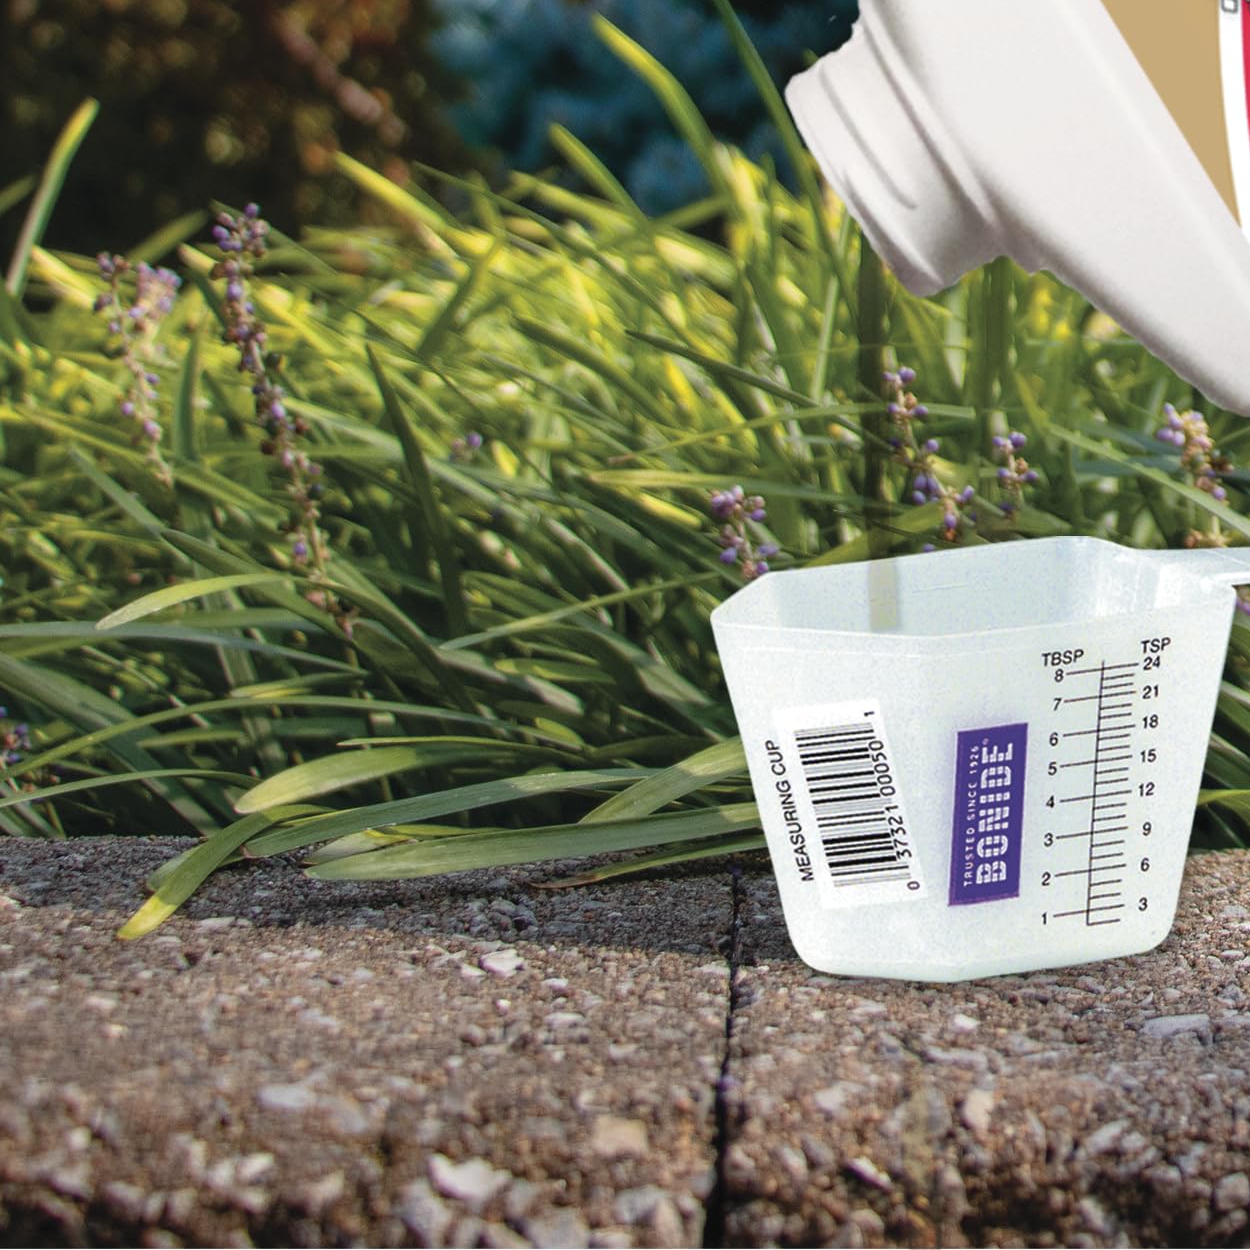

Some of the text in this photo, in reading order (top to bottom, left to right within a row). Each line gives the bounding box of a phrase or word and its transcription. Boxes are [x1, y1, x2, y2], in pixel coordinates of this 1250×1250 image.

[1141, 637, 1171, 654] TSP
[1041, 649, 1084, 667] TBSP
[1143, 656, 1161, 671] 24
[1054, 669, 1064, 683] 8
[1142, 685, 1159, 700] 21
[1053, 698, 1062, 711] 7
[1142, 714, 1159, 729] 18
[1049, 732, 1059, 746] 6
[1140, 748, 1157, 763] 15
[868, 740, 896, 796] 00050
[1048, 761, 1057, 776] 5
[1138, 782, 1155, 797] 12
[1046, 795, 1055, 808] 4
[765, 740, 814, 882] MEASURING CUP
[963, 745, 980, 887] TRUSTED SINCE 1926
[976, 742, 1013, 884] BONIDE
[886, 805, 912, 860] 37321
[1142, 821, 1152, 837] 9
[1043, 832, 1054, 848] 3
[1140, 857, 1150, 872] 6
[907, 881, 920, 891] 0
[1041, 871, 1051, 887] 2
[1138, 897, 1148, 911] 3
[1041, 912, 1048, 925] 1
